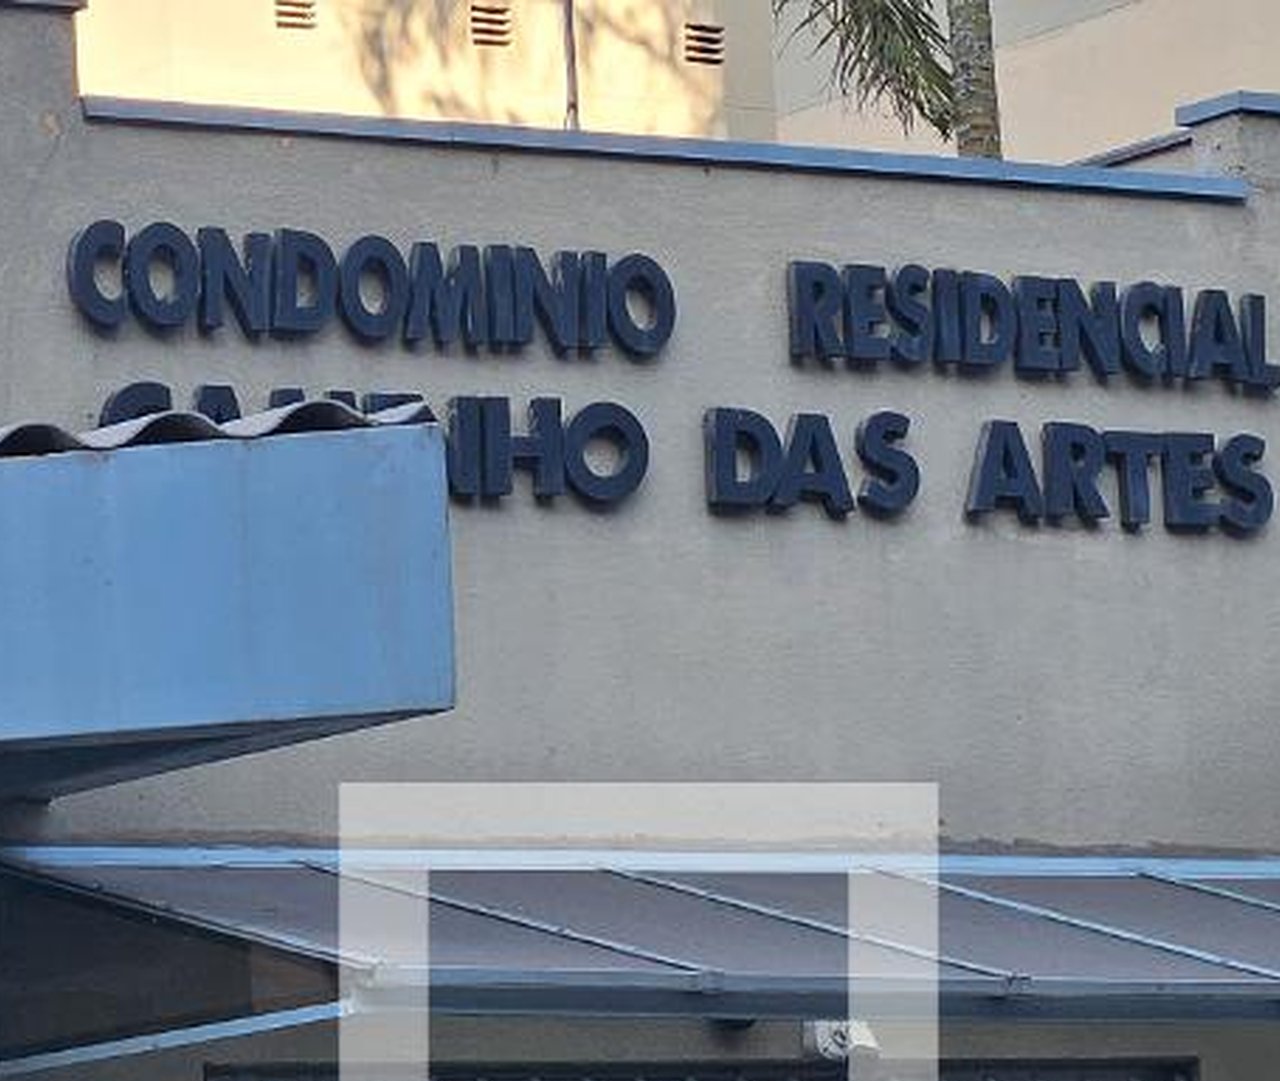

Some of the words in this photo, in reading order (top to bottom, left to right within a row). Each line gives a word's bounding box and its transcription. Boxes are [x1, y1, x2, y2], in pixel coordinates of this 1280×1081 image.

[67, 219, 676, 358] CONDOMINIO
[704, 406, 922, 519] DAS
[964, 420, 1275, 535] ARTES
